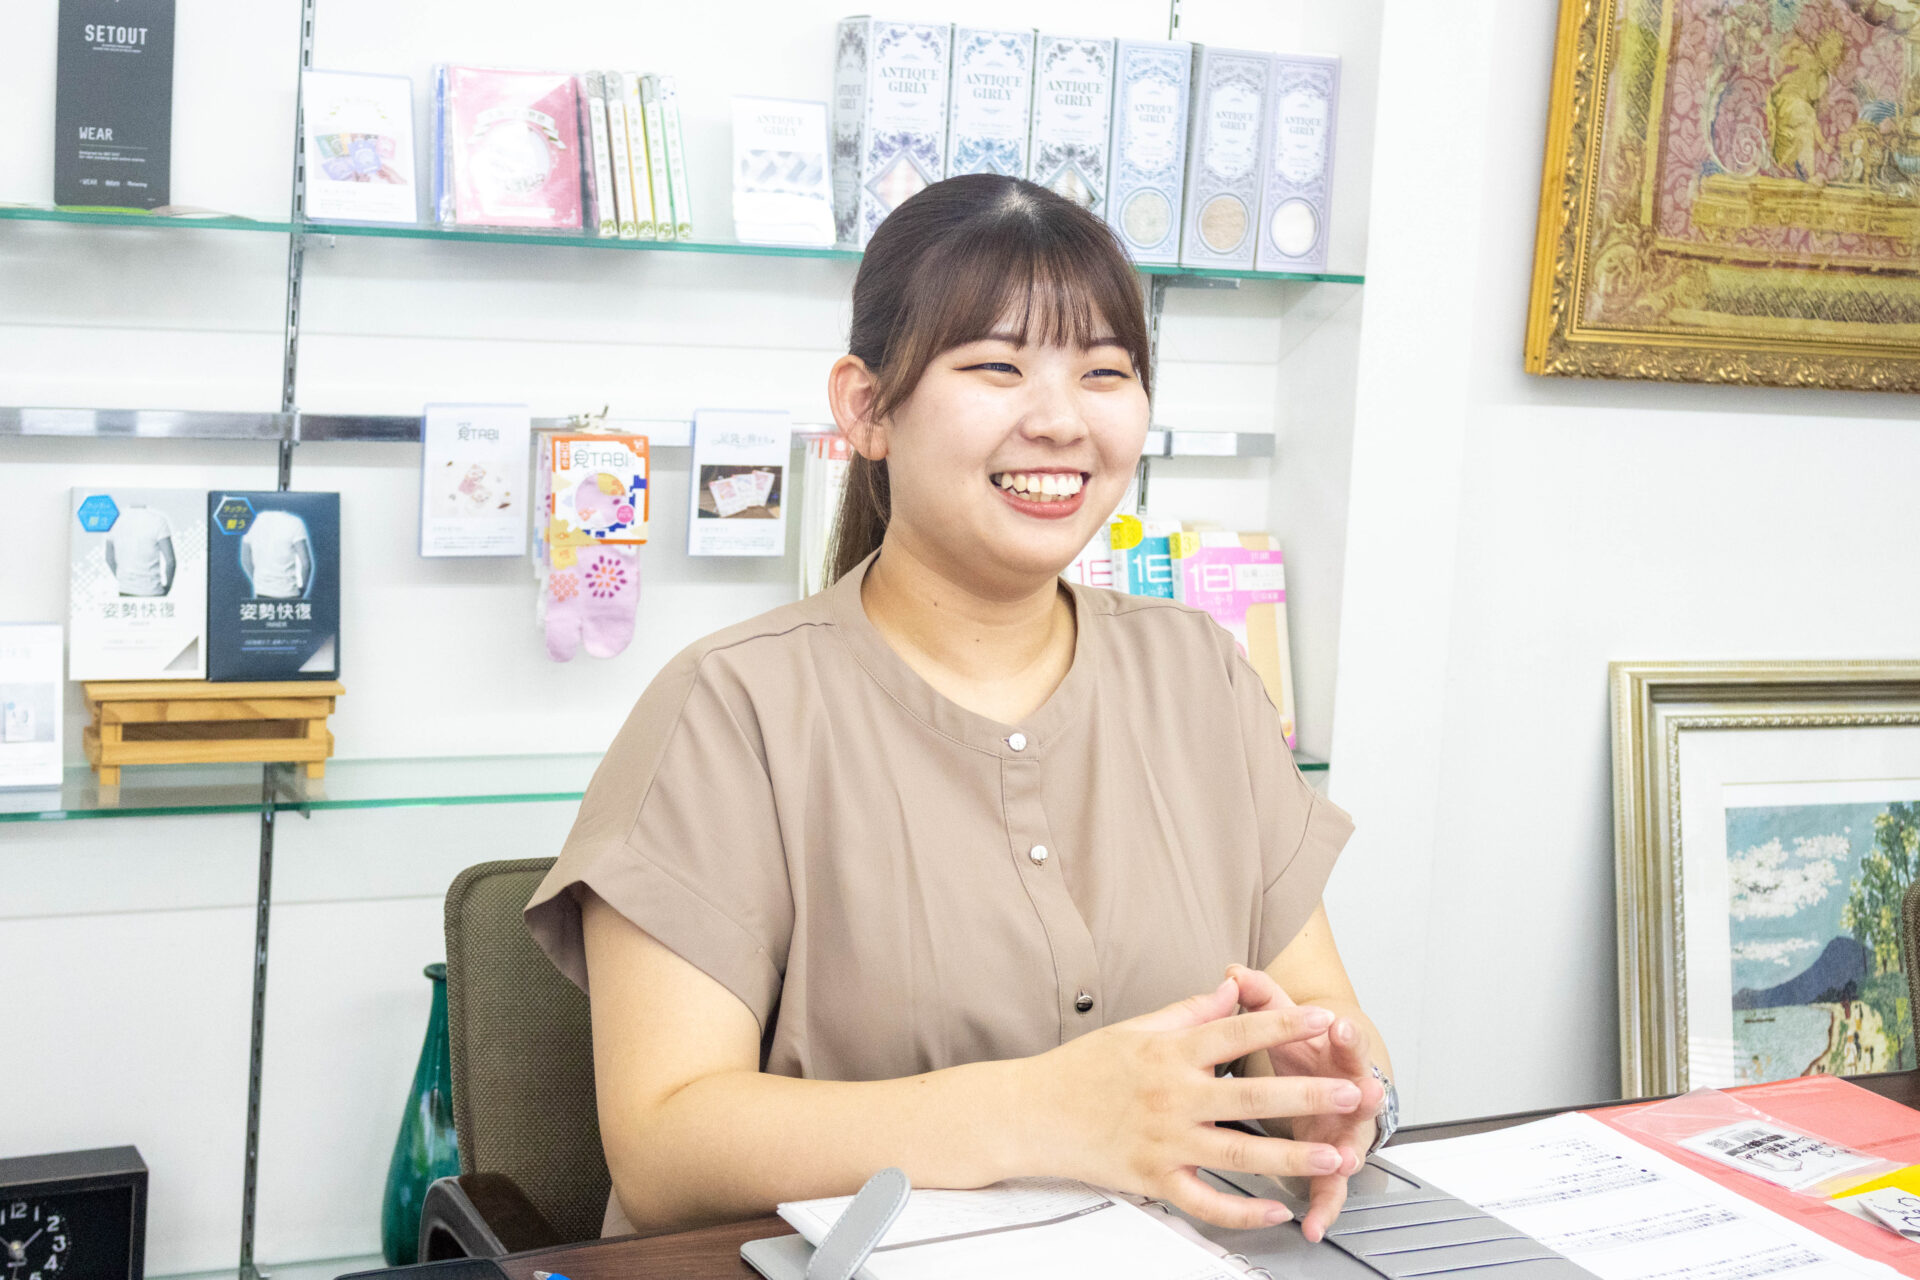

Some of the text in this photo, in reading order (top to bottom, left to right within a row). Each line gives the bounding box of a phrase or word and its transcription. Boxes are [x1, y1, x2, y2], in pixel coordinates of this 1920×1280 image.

[85, 24, 148, 45] SETOUT
[879, 66, 939, 82] ANTIQUE
[964, 73, 1022, 88] ANTIQUE
[888, 82, 930, 94] GIRLY
[972, 88, 1012, 101] GIRLY
[1046, 80, 1103, 94] ANTIQUE
[1054, 94, 1094, 107] GIRLY
[1134, 103, 1173, 114] ANTIQUE
[1138, 114, 1167, 124] GIRLY
[1215, 111, 1254, 122] ANTIQUE
[1285, 116, 1323, 127] ANTIQUE
[79, 126, 113, 141] WEAR
[1220, 121, 1248, 131] GIRLY
[1289, 126, 1315, 137] GIRLY
[1189, 563, 1234, 593] 1日
[102, 602, 176, 619] 姿勢快復
[240, 603, 312, 621] 姿勢快復
[10, 1202, 28, 1219] 12
[34, 1206, 39, 1221] 1
[46, 1215, 60, 1232] 2
[52, 1235, 66, 1252] 3
[44, 1254, 58, 1271] 4
